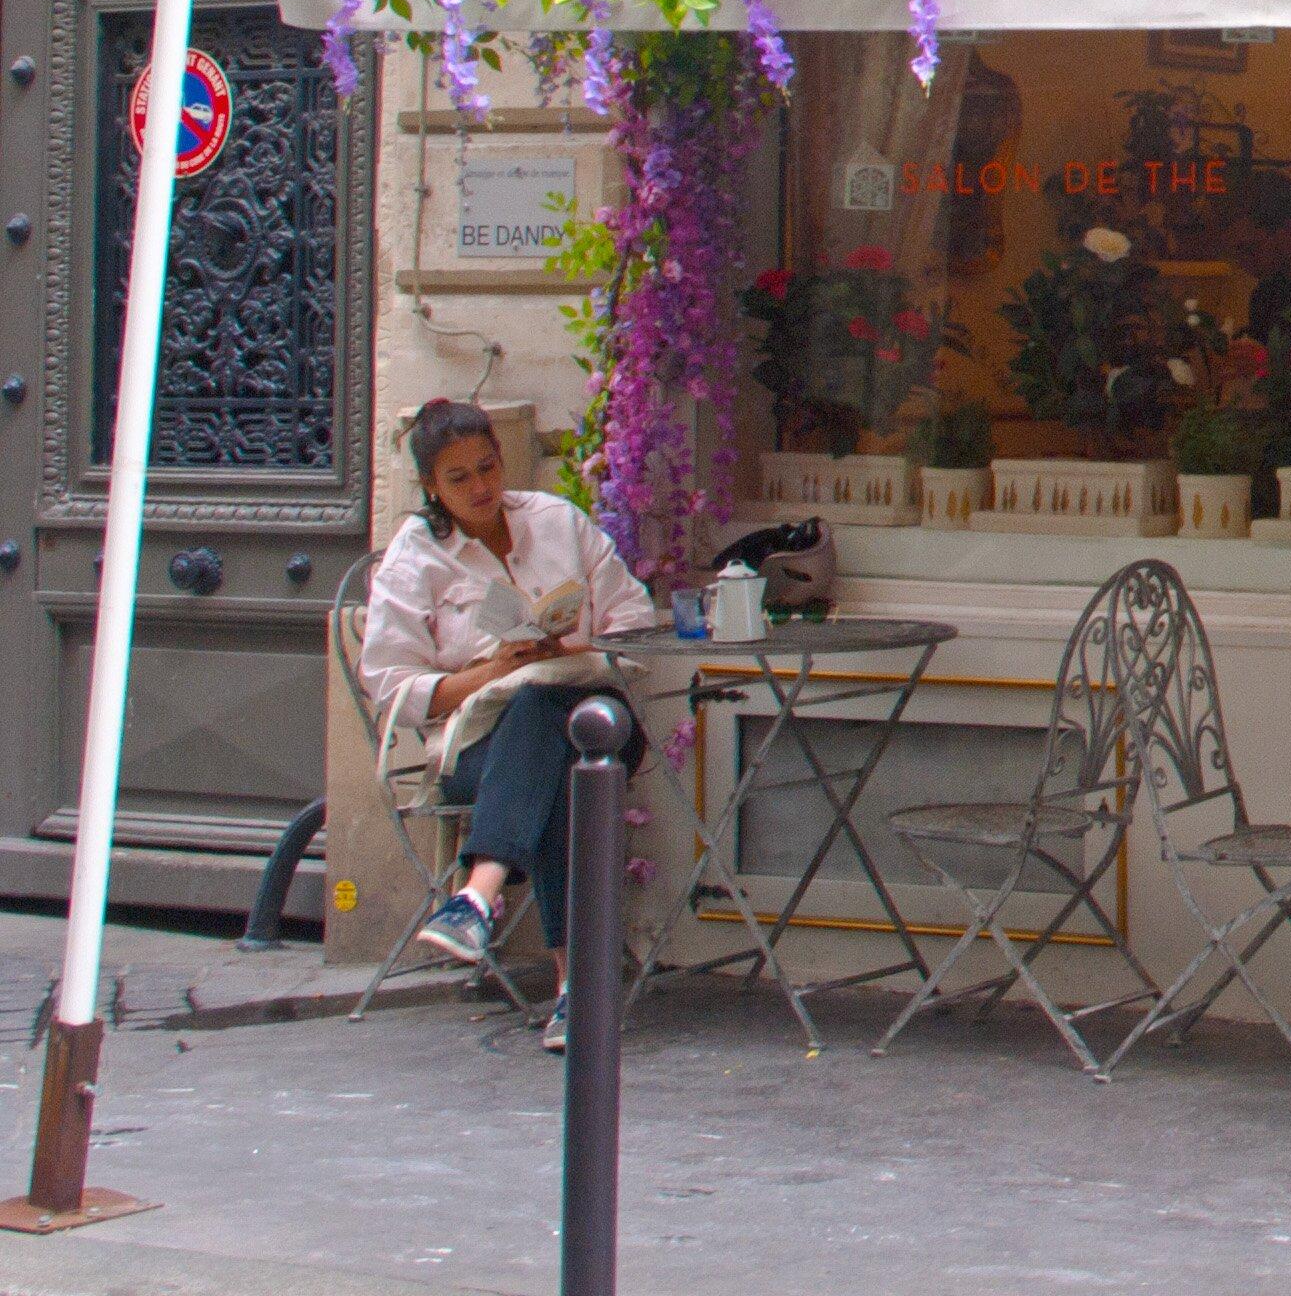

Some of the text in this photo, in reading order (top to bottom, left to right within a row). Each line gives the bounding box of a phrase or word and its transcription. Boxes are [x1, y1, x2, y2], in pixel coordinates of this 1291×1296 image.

[899, 160, 1042, 195] SALON
[1063, 160, 1120, 195] DE
[462, 225, 490, 246] BE
